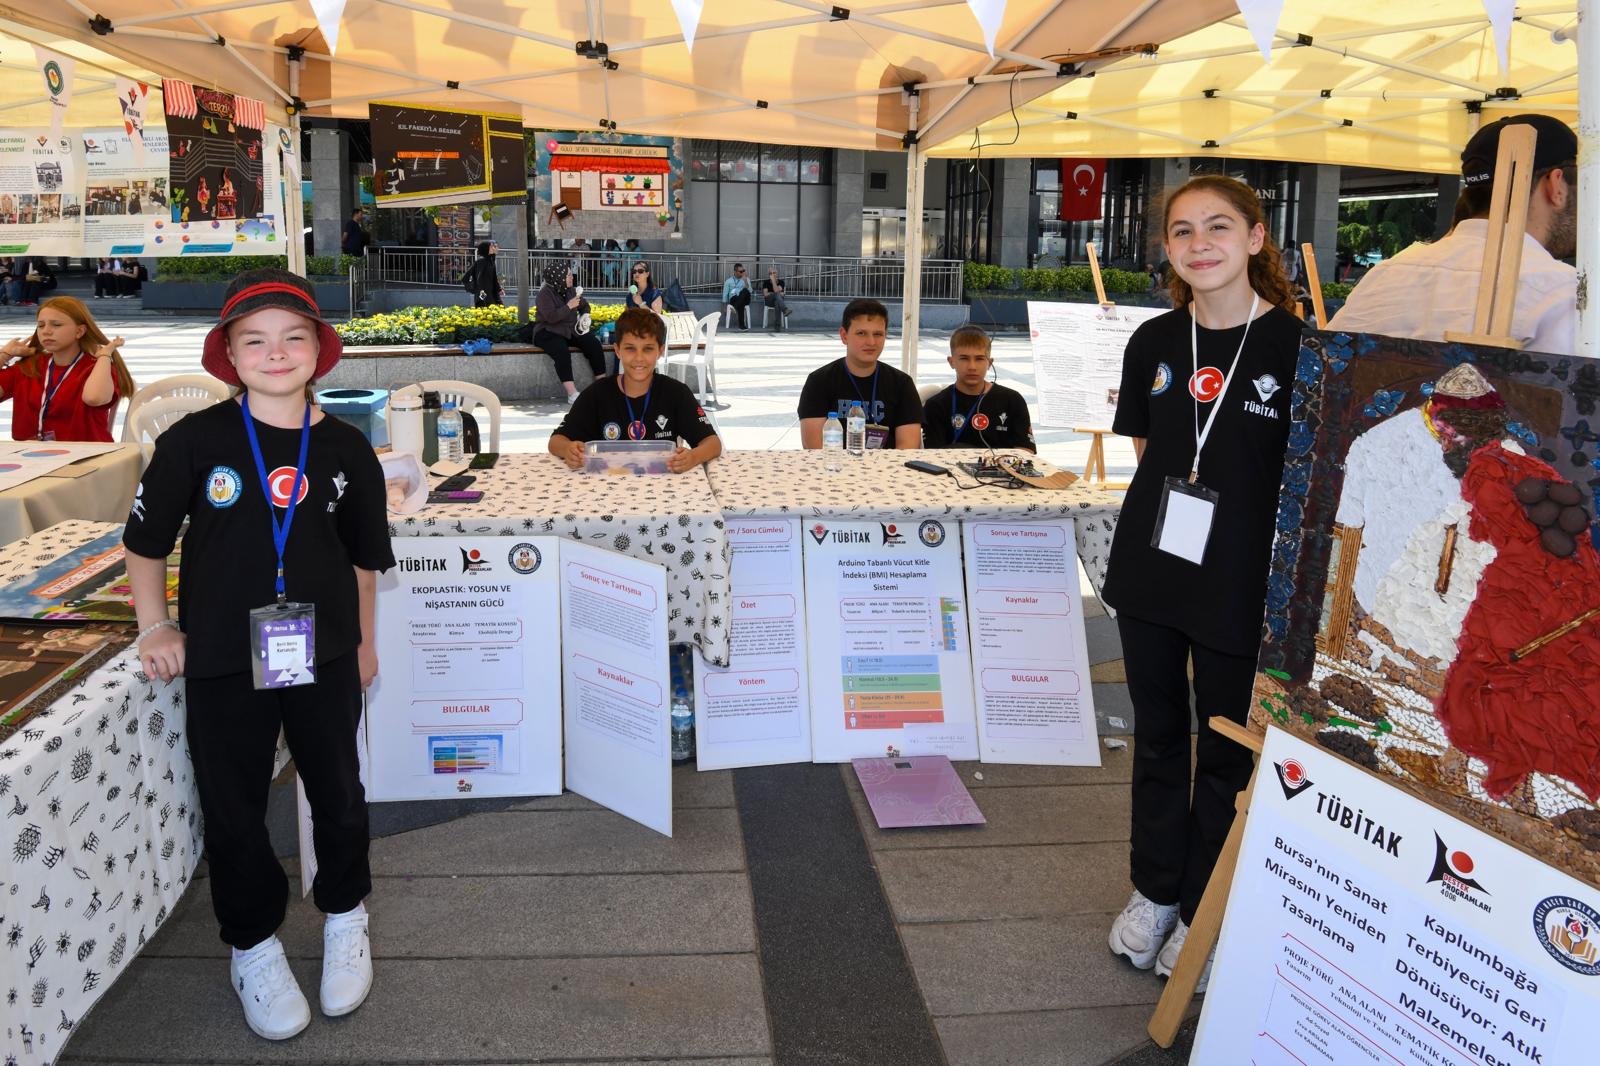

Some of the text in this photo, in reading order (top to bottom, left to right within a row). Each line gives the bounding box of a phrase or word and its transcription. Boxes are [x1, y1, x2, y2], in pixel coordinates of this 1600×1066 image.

[1466, 173, 1489, 183] POLİS
[832, 530, 870, 544] TÜBİTAK
[991, 529, 1010, 538] Sonuç
[399, 557, 447, 572] TÜBİTAK
[838, 559, 865, 567] Arduino
[893, 558, 913, 566] Vücut
[843, 570, 866, 579] İndeksi
[890, 571, 927, 580] Hesaplama
[412, 585, 466, 594] EKOPLASTİK:
[581, 571, 600, 584] Sonuç
[610, 580, 641, 596] Tartışma
[873, 583, 898, 591] Sistemi
[425, 599, 504, 610] NİŞASTANIN GÜCÜ
[1005, 596, 1038, 605] Kaynaklar
[597, 668, 634, 686] Kaynaklar
[1011, 675, 1049, 683] BULGULAR
[442, 704, 490, 714] BULGULAR
[1316, 792, 1403, 858] TÜBİTAK
[1274, 836, 1388, 915] Bursa'nın Sanat
[1443, 873, 1469, 893] DESTEK
[1265, 858, 1386, 944] Mirasını Yeniden
[1440, 888, 1456, 902] 4006
[1442, 881, 1492, 913] PROGRAMLARI
[1281, 894, 1355, 953] Tasarlama
[1424, 914, 1538, 995] Kaplumbağa
[1406, 934, 1546, 1032] Terbiyecisi Geri
[1284, 946, 1309, 968] PROJE
[1310, 965, 1334, 986] TÜRÜ
[1339, 986, 1357, 1002] ANA
[1359, 1000, 1387, 1023] ALANI
[1395, 1024, 1440, 1060] TEMATİK
[1286, 959, 1312, 982] Tasarım
[1330, 992, 1362, 1018] Teknoloji
[1363, 1016, 1371, 1025] ve
[1373, 1021, 1401, 1046] Tasarım
[1331, 1024, 1345, 1037] ALAN
[1502, 1030, 1543, 1065] Atık
